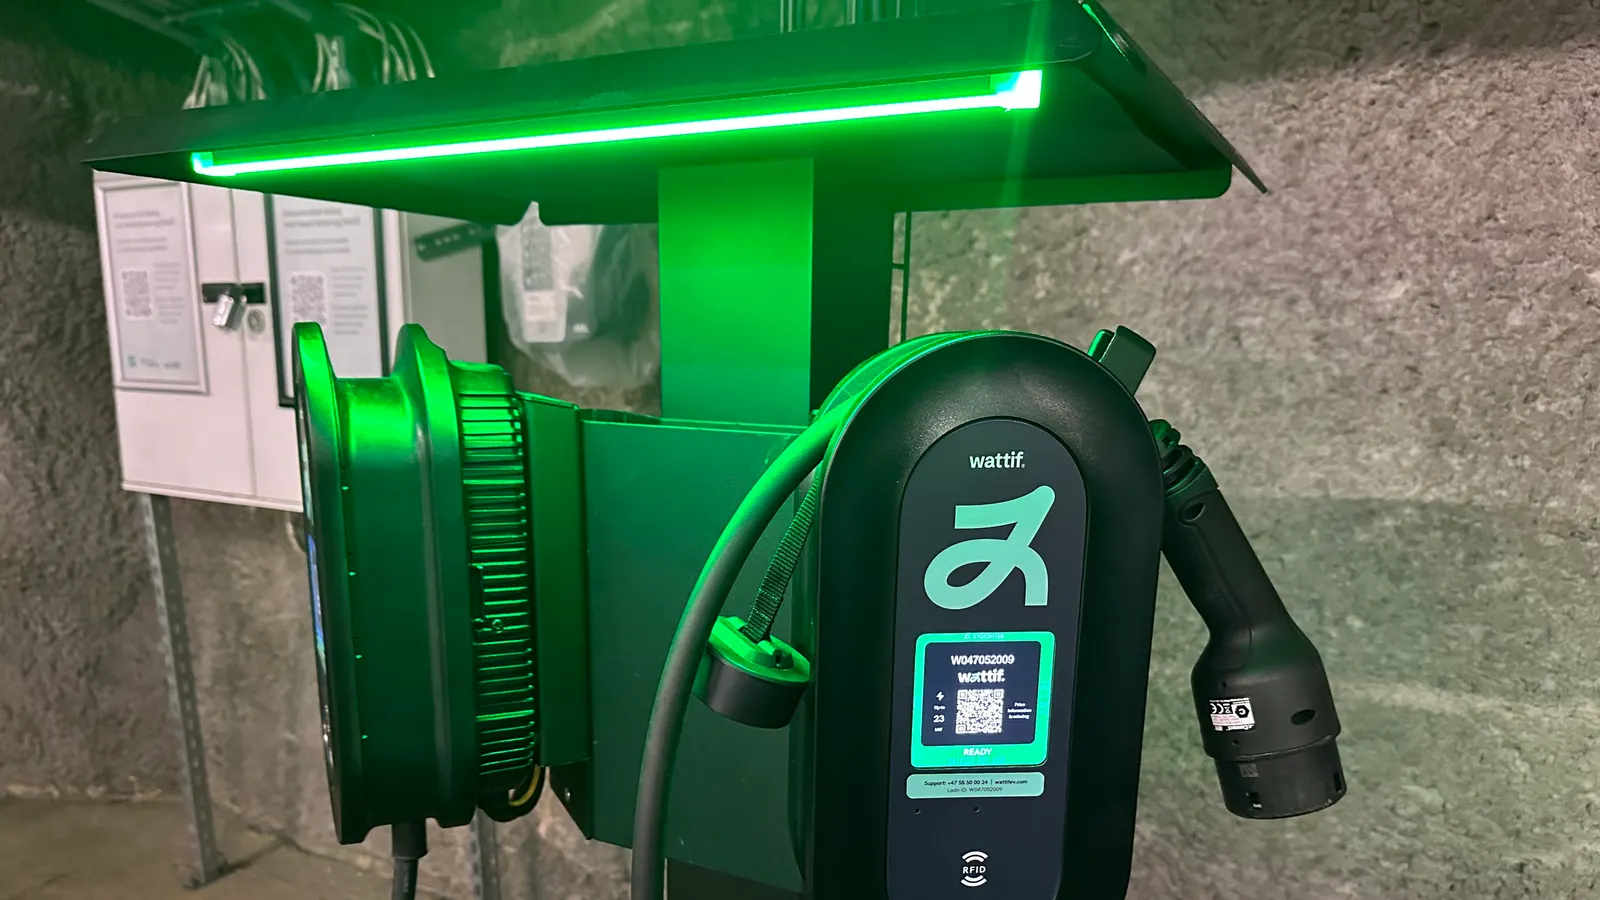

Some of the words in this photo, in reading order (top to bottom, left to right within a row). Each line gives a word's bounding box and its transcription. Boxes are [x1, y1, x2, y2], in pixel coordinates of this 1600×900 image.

[950, 654, 1015, 665] W047052009
[933, 714, 946, 723] 23
[963, 747, 992, 756] READY
[962, 865, 987, 874] RFID
